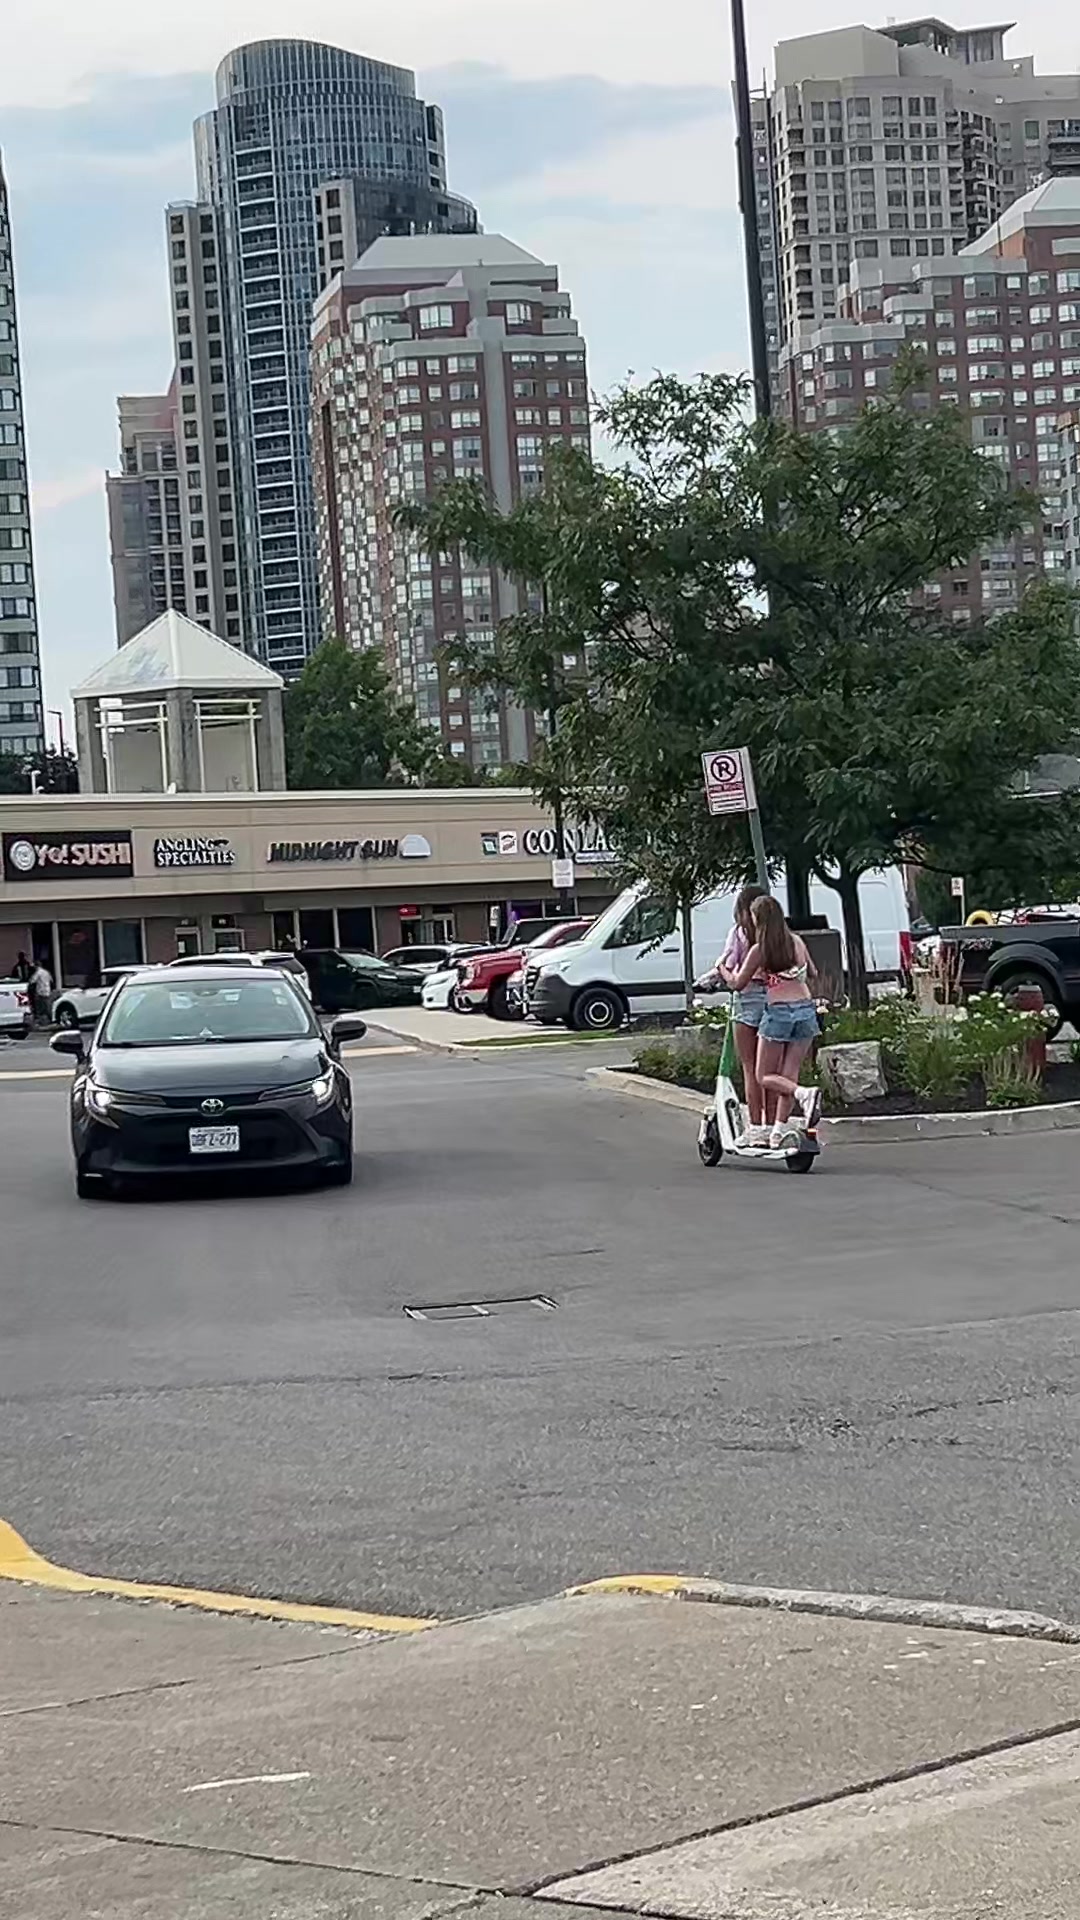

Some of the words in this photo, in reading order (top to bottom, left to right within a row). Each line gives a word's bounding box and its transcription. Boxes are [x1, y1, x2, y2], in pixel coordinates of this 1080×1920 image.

[155, 838, 214, 852] ANGLING
[267, 840, 359, 862] MIDNIGHT
[360, 838, 399, 859] SUN
[524, 828, 580, 854] CON
[70, 842, 131, 865] SUSHI
[156, 850, 235, 866] SPECIALTIES
